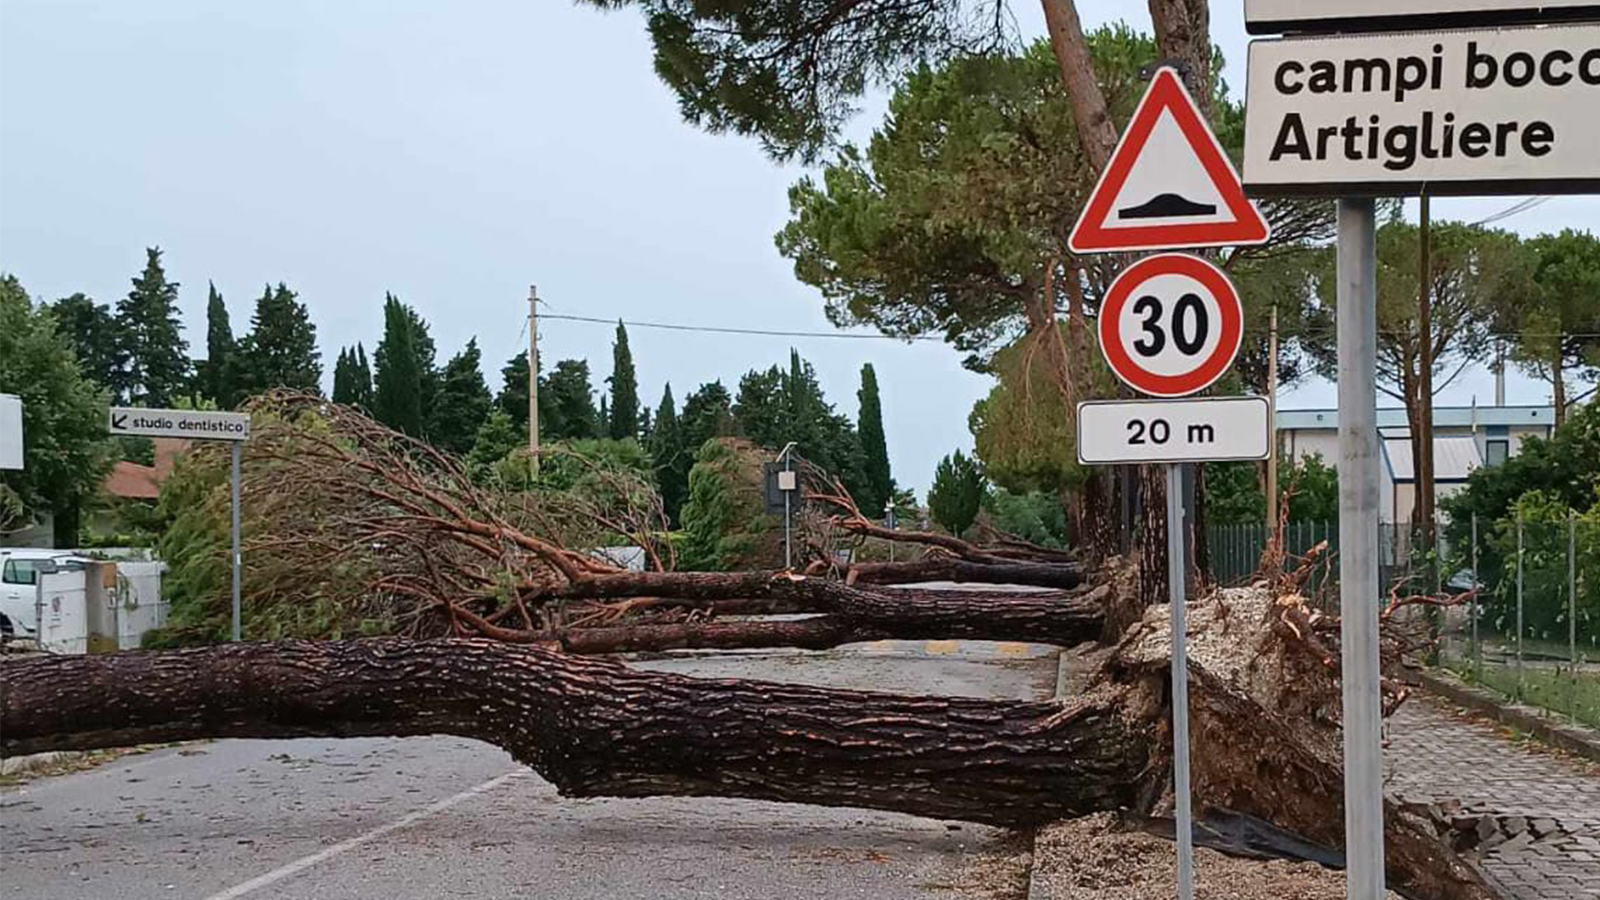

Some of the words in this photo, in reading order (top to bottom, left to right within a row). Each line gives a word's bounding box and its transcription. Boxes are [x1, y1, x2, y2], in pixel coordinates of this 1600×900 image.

[1274, 43, 1443, 102] campi
[1268, 111, 1554, 171] Artigliere
[1132, 293, 1209, 357] 30
[133, 417, 173, 429] studio
[178, 419, 243, 432] dentistico
[1126, 418, 1171, 445] 20
[1187, 423, 1215, 443] m
